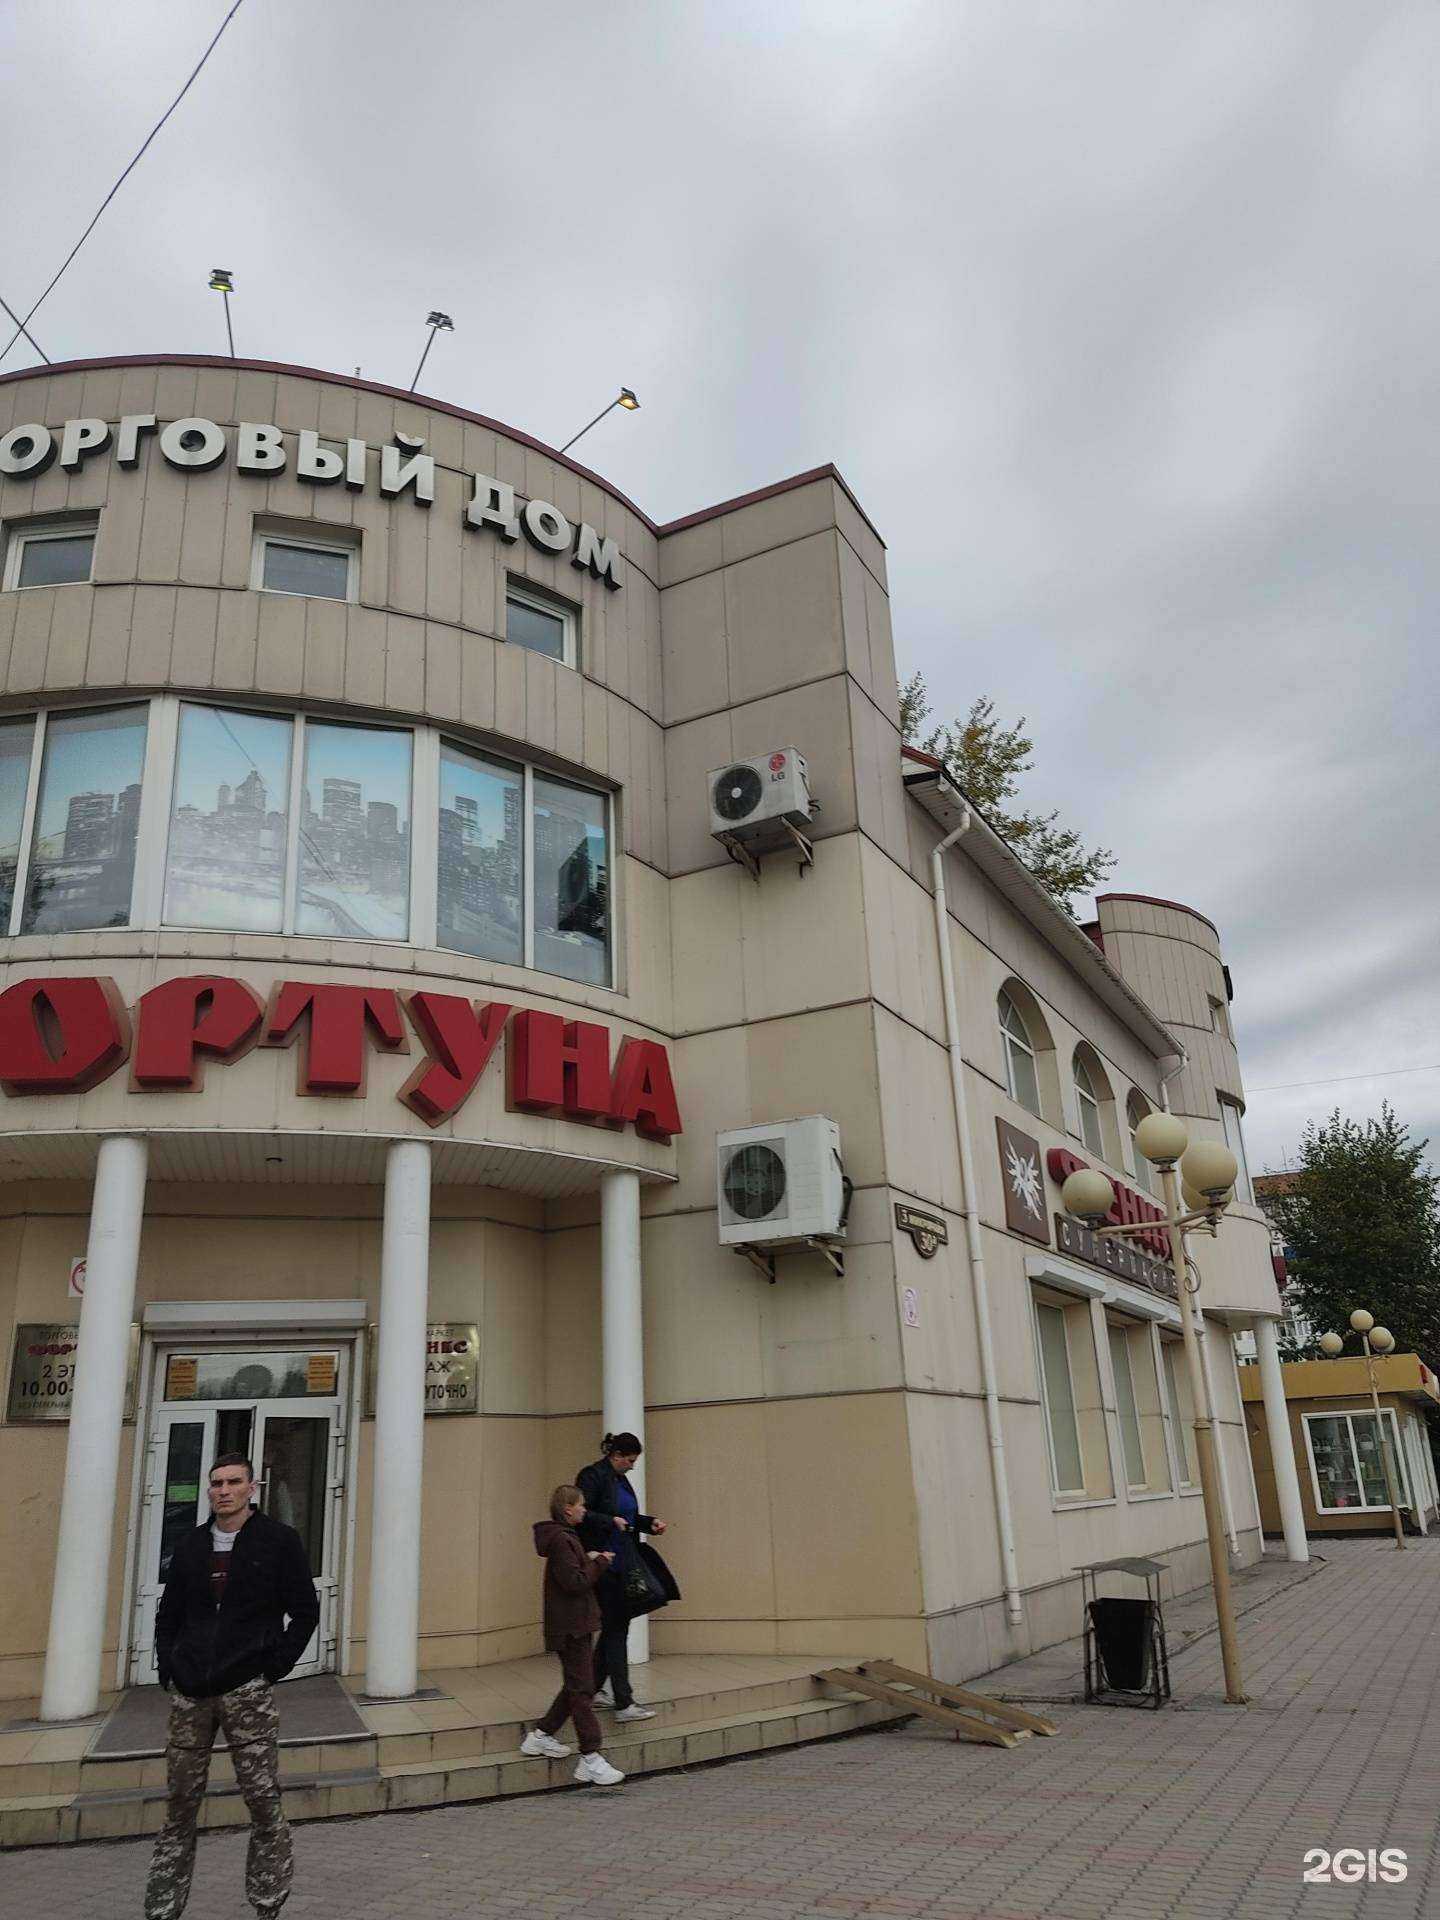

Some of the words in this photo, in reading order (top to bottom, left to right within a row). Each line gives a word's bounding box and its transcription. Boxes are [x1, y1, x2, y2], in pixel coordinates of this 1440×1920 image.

[463, 473, 623, 591] ДОМ
[771, 771, 786, 782] LG
[42, 1364, 52, 1378] 2
[58, 1364, 76, 1378] ЭТ
[425, 1361, 450, 1373] АЖ
[21, 1380, 75, 1396] 10.00-
[424, 1384, 468, 1399] УТОЧНО
